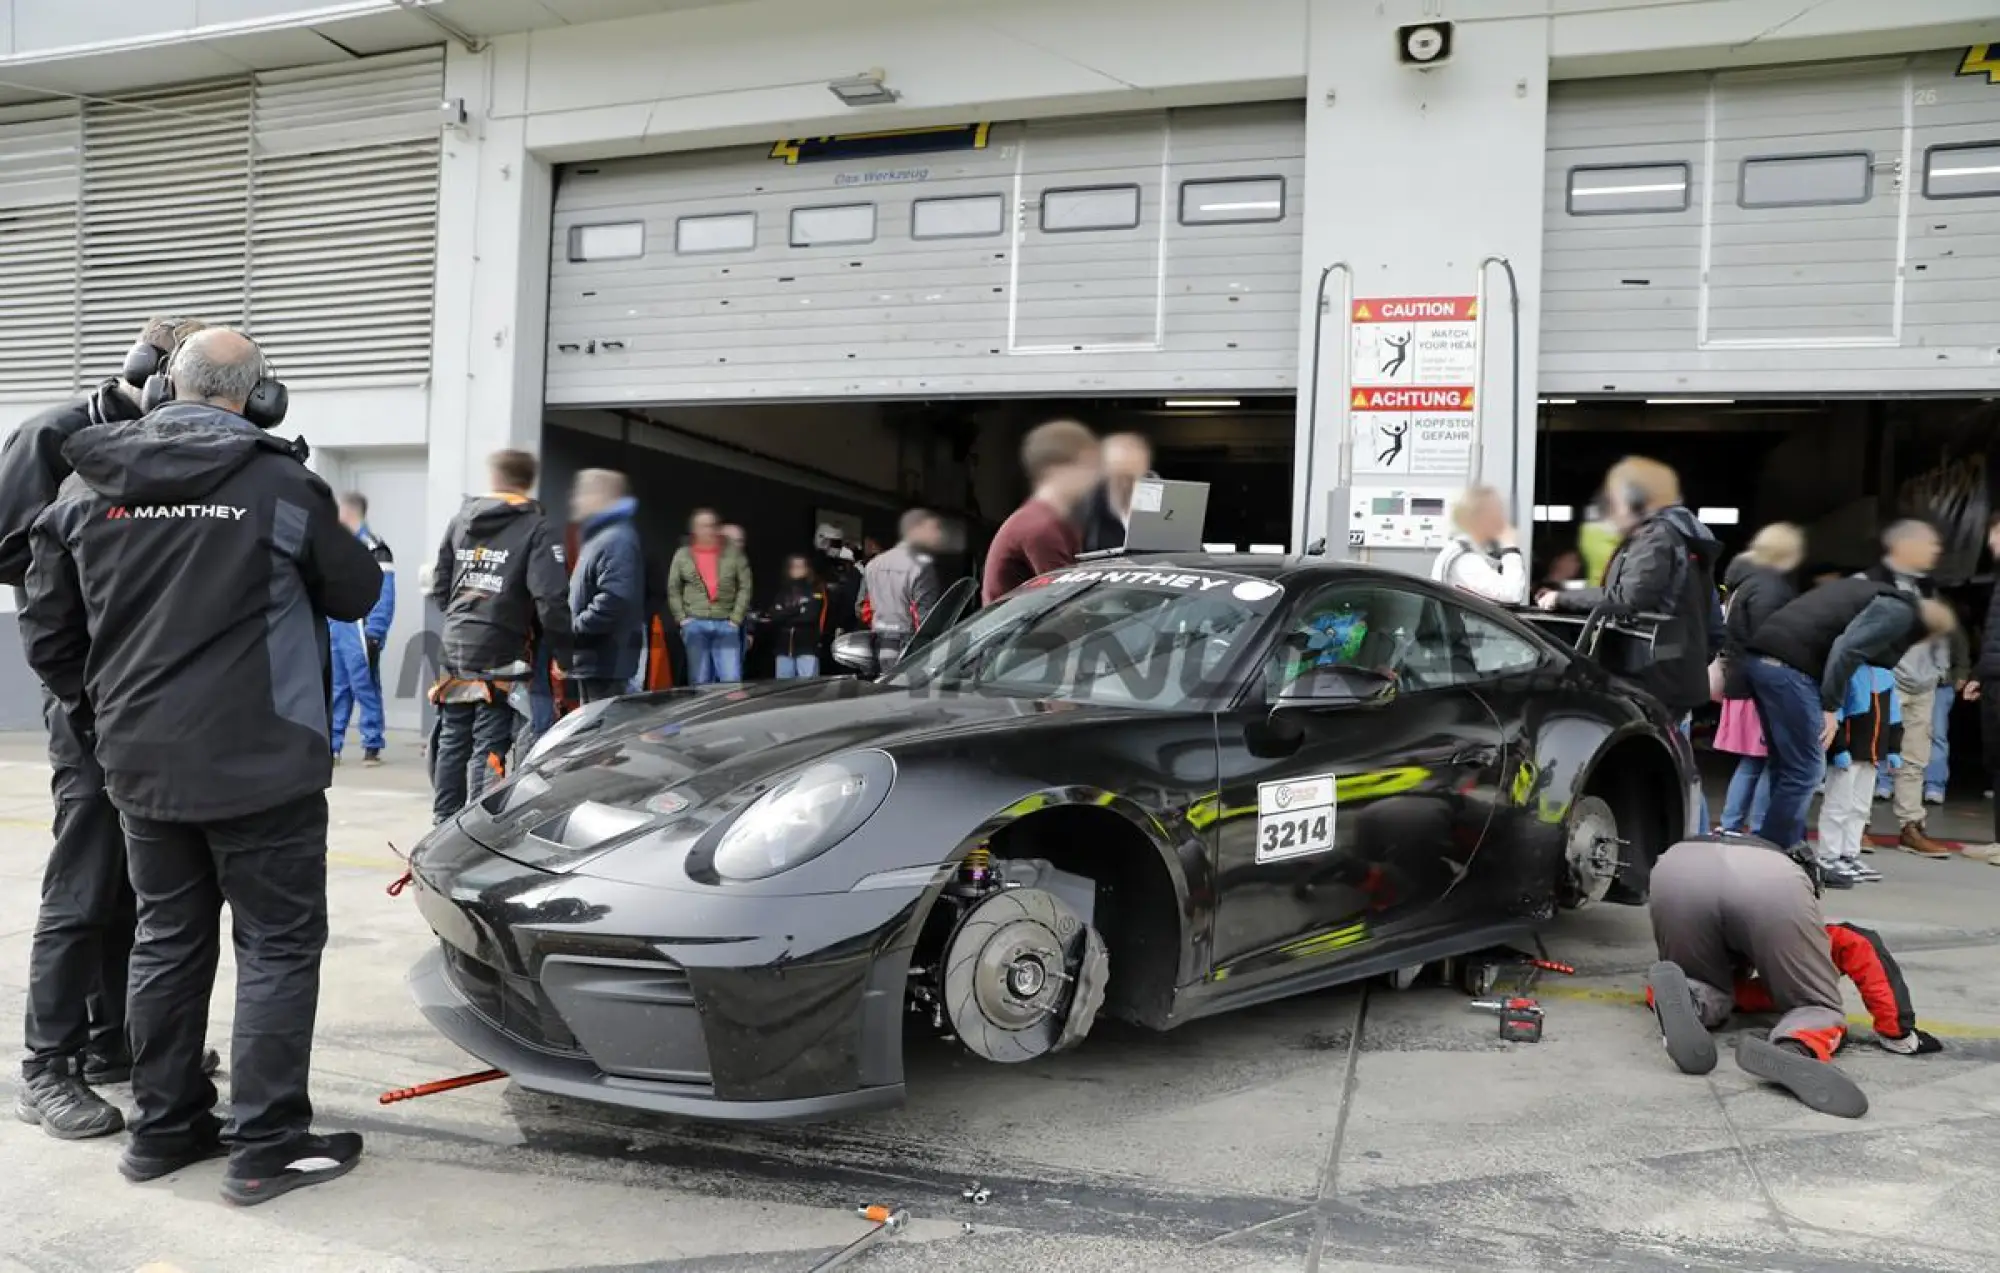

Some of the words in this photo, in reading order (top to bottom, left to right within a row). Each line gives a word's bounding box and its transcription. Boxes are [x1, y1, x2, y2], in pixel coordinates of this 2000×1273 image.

[1914, 89, 1937, 106] 26
[1381, 302, 1456, 317] CAUTION
[1431, 328, 1469, 338] WATCH
[1419, 341, 1447, 350] YOUR
[1370, 391, 1461, 407] ACHTUNG
[1421, 431, 1470, 441] GEFAHR
[134, 504, 247, 521] MANTHEY
[1051, 571, 1230, 591] MANTHEY
[1262, 815, 1328, 852] 3214
